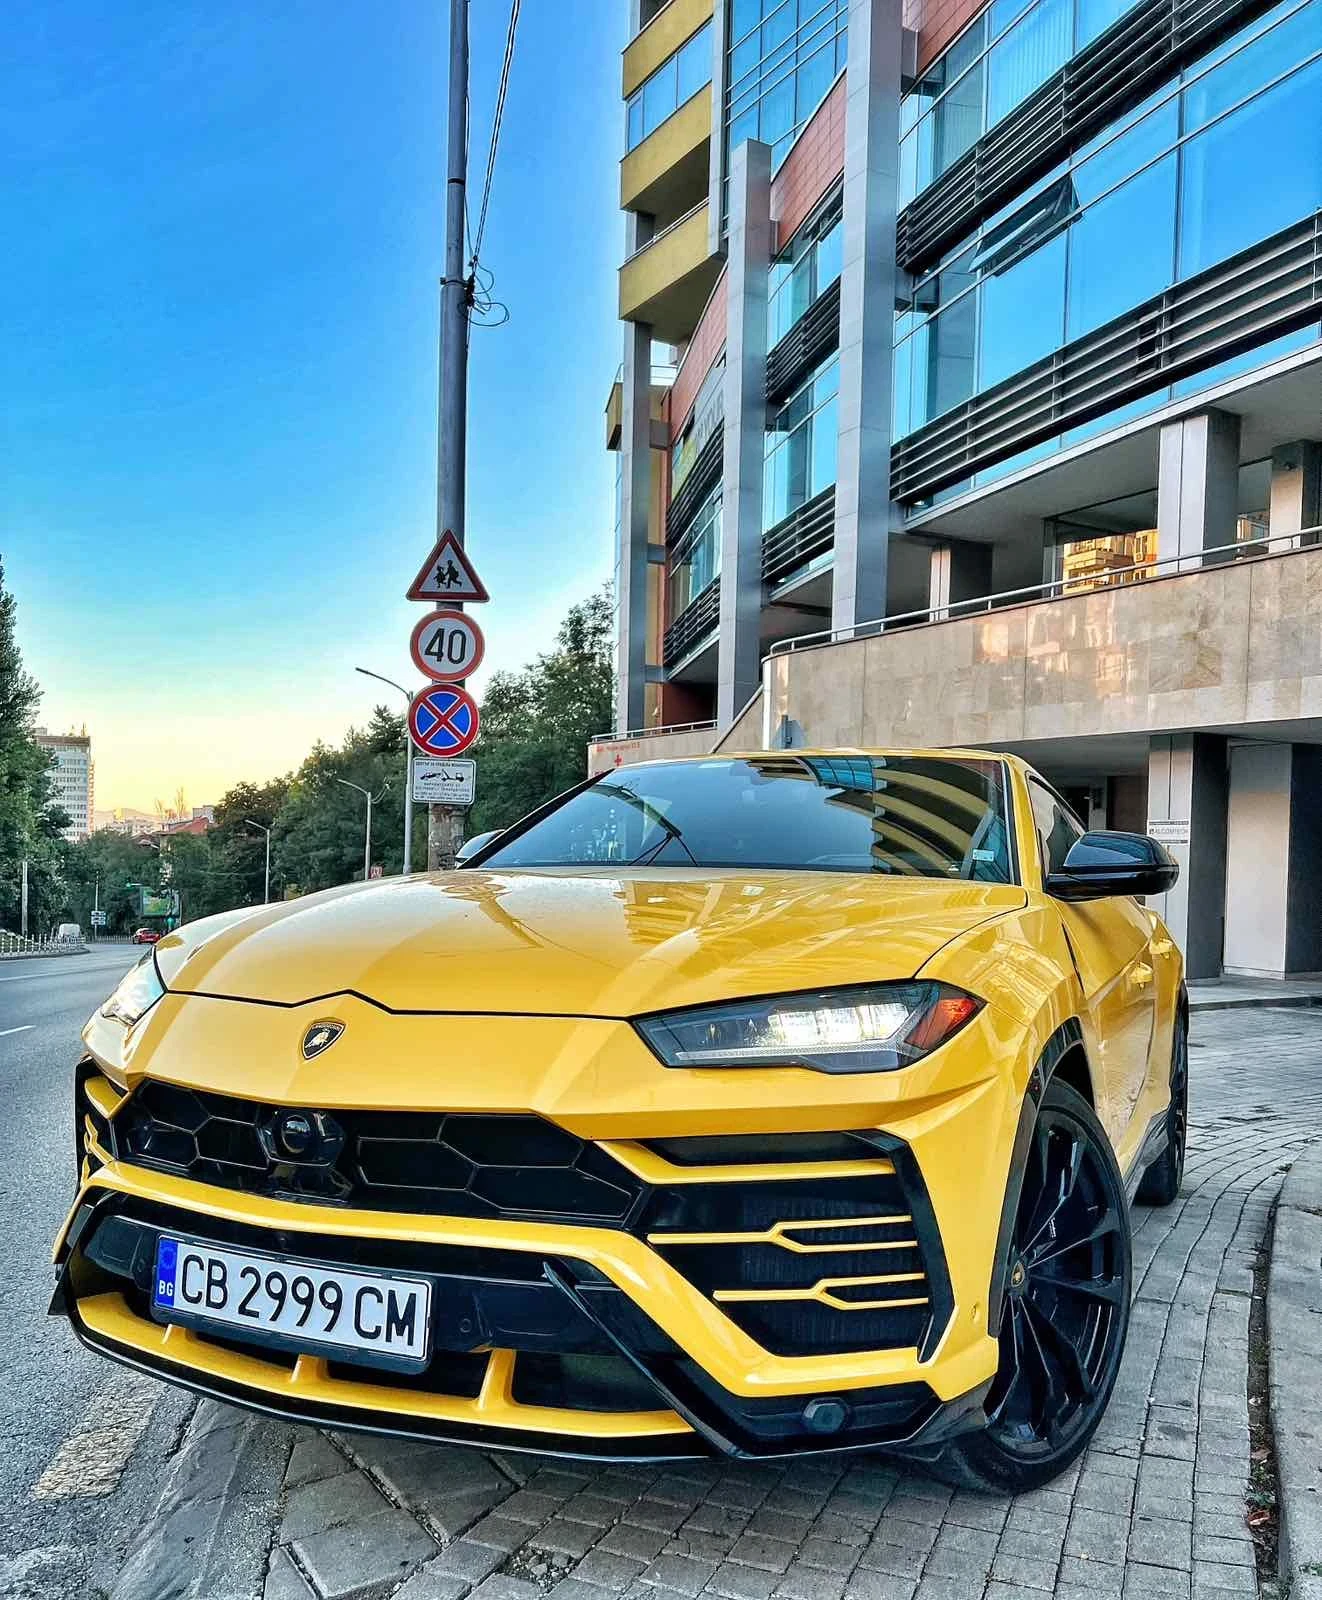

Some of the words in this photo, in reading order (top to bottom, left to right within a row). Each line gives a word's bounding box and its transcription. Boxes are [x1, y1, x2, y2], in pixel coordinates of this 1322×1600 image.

[424, 628, 467, 664] 40
[158, 1282, 174, 1297] BG
[181, 1254, 228, 1310] CB
[237, 1266, 343, 1332] 2999
[354, 1285, 417, 1346] CM
